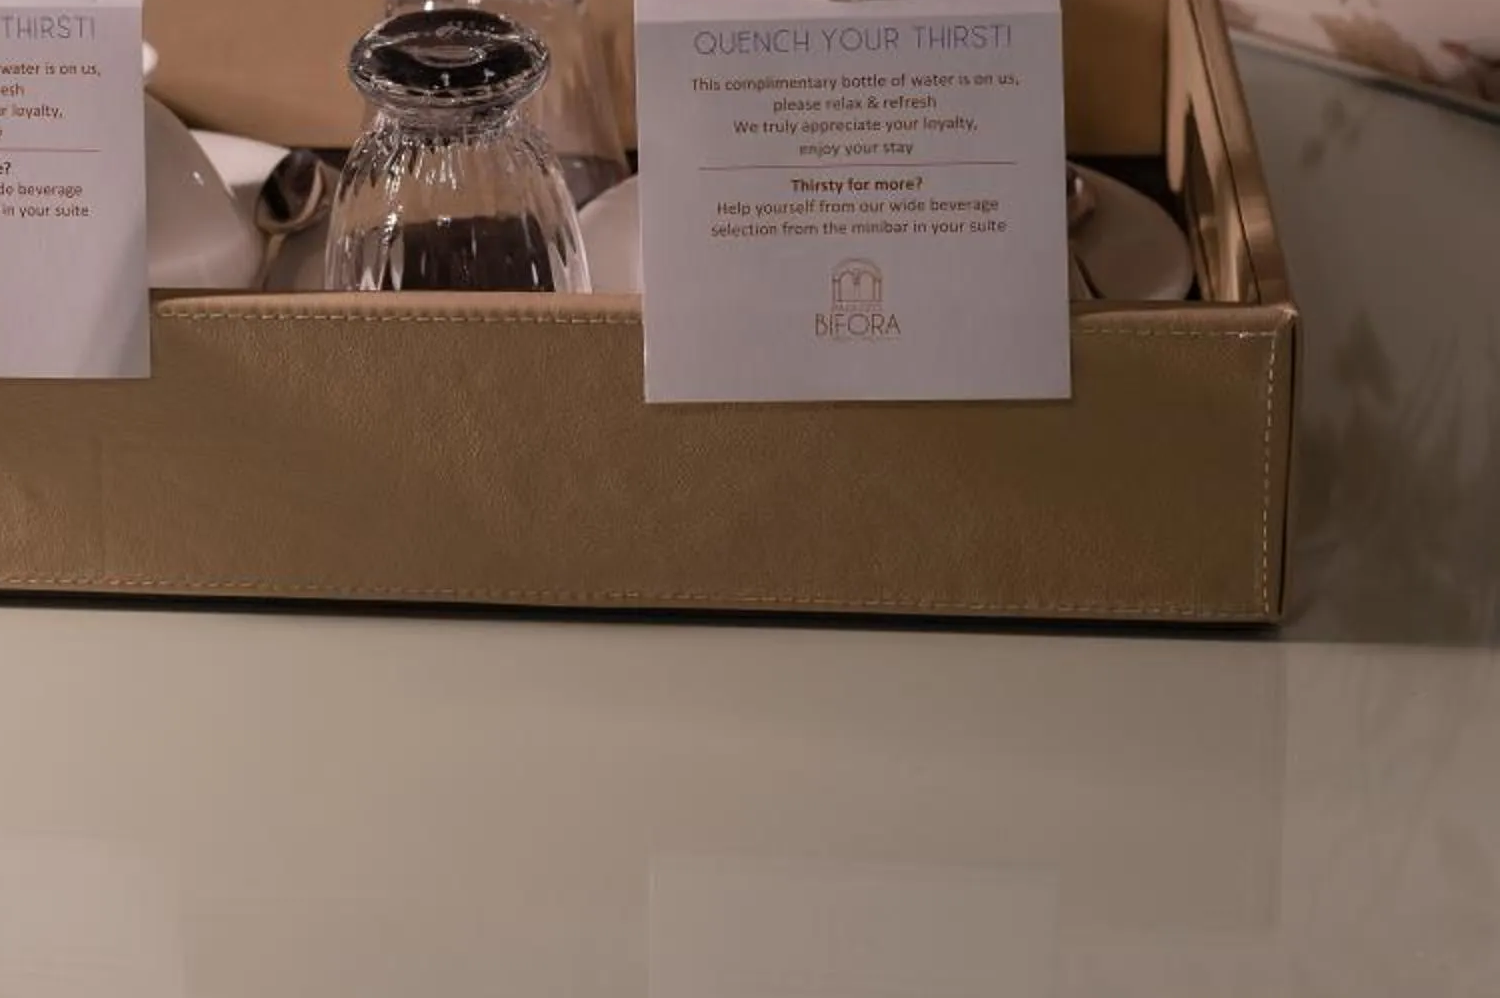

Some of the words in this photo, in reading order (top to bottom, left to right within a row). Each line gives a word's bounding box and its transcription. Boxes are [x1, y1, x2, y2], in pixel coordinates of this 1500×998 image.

[0, 16, 95, 40] THIRST!
[693, 30, 809, 55] QUENCH
[821, 27, 899, 52] YOUR
[914, 24, 1012, 49] THIRST!
[0, 64, 40, 75] water
[45, 64, 56, 75] is
[60, 65, 76, 75] on
[82, 65, 100, 77] us,
[691, 79, 720, 92] This
[725, 77, 837, 93] complimentary
[841, 74, 886, 89] bottle
[891, 74, 906, 87] of
[911, 75, 954, 87] water
[959, 74, 970, 85] is
[974, 74, 993, 85] on
[999, 74, 1020, 86] us,
[12, 105, 62, 120] loyalty,
[773, 98, 821, 113] please
[825, 98, 862, 110] relax
[866, 96, 879, 109] &
[883, 95, 937, 109] refresh
[733, 121, 759, 134] We
[763, 120, 798, 135] truly
[801, 118, 881, 133] appreciate
[885, 119, 918, 132] your
[923, 116, 978, 132] loyalty,
[799, 143, 840, 159] enjoy
[844, 144, 879, 156] your
[883, 143, 914, 155] stay
[18, 184, 83, 198] beverage
[790, 179, 843, 194] Thirsty
[848, 178, 870, 192] for
[875, 177, 923, 192] more?
[2, 204, 14, 216] in
[19, 207, 50, 218] your
[55, 206, 90, 216] suite
[716, 202, 751, 217] Help
[755, 202, 815, 217] yourself
[819, 201, 855, 214] from
[859, 202, 884, 213] our
[889, 200, 924, 212] wide
[929, 199, 999, 212] beverage
[711, 224, 777, 237] selection
[782, 223, 819, 235] from
[823, 222, 847, 235] the
[851, 221, 909, 234] minibar
[912, 221, 927, 233] in
[931, 222, 965, 235] your
[970, 220, 1007, 233] suite
[814, 313, 901, 336] BIFORA
